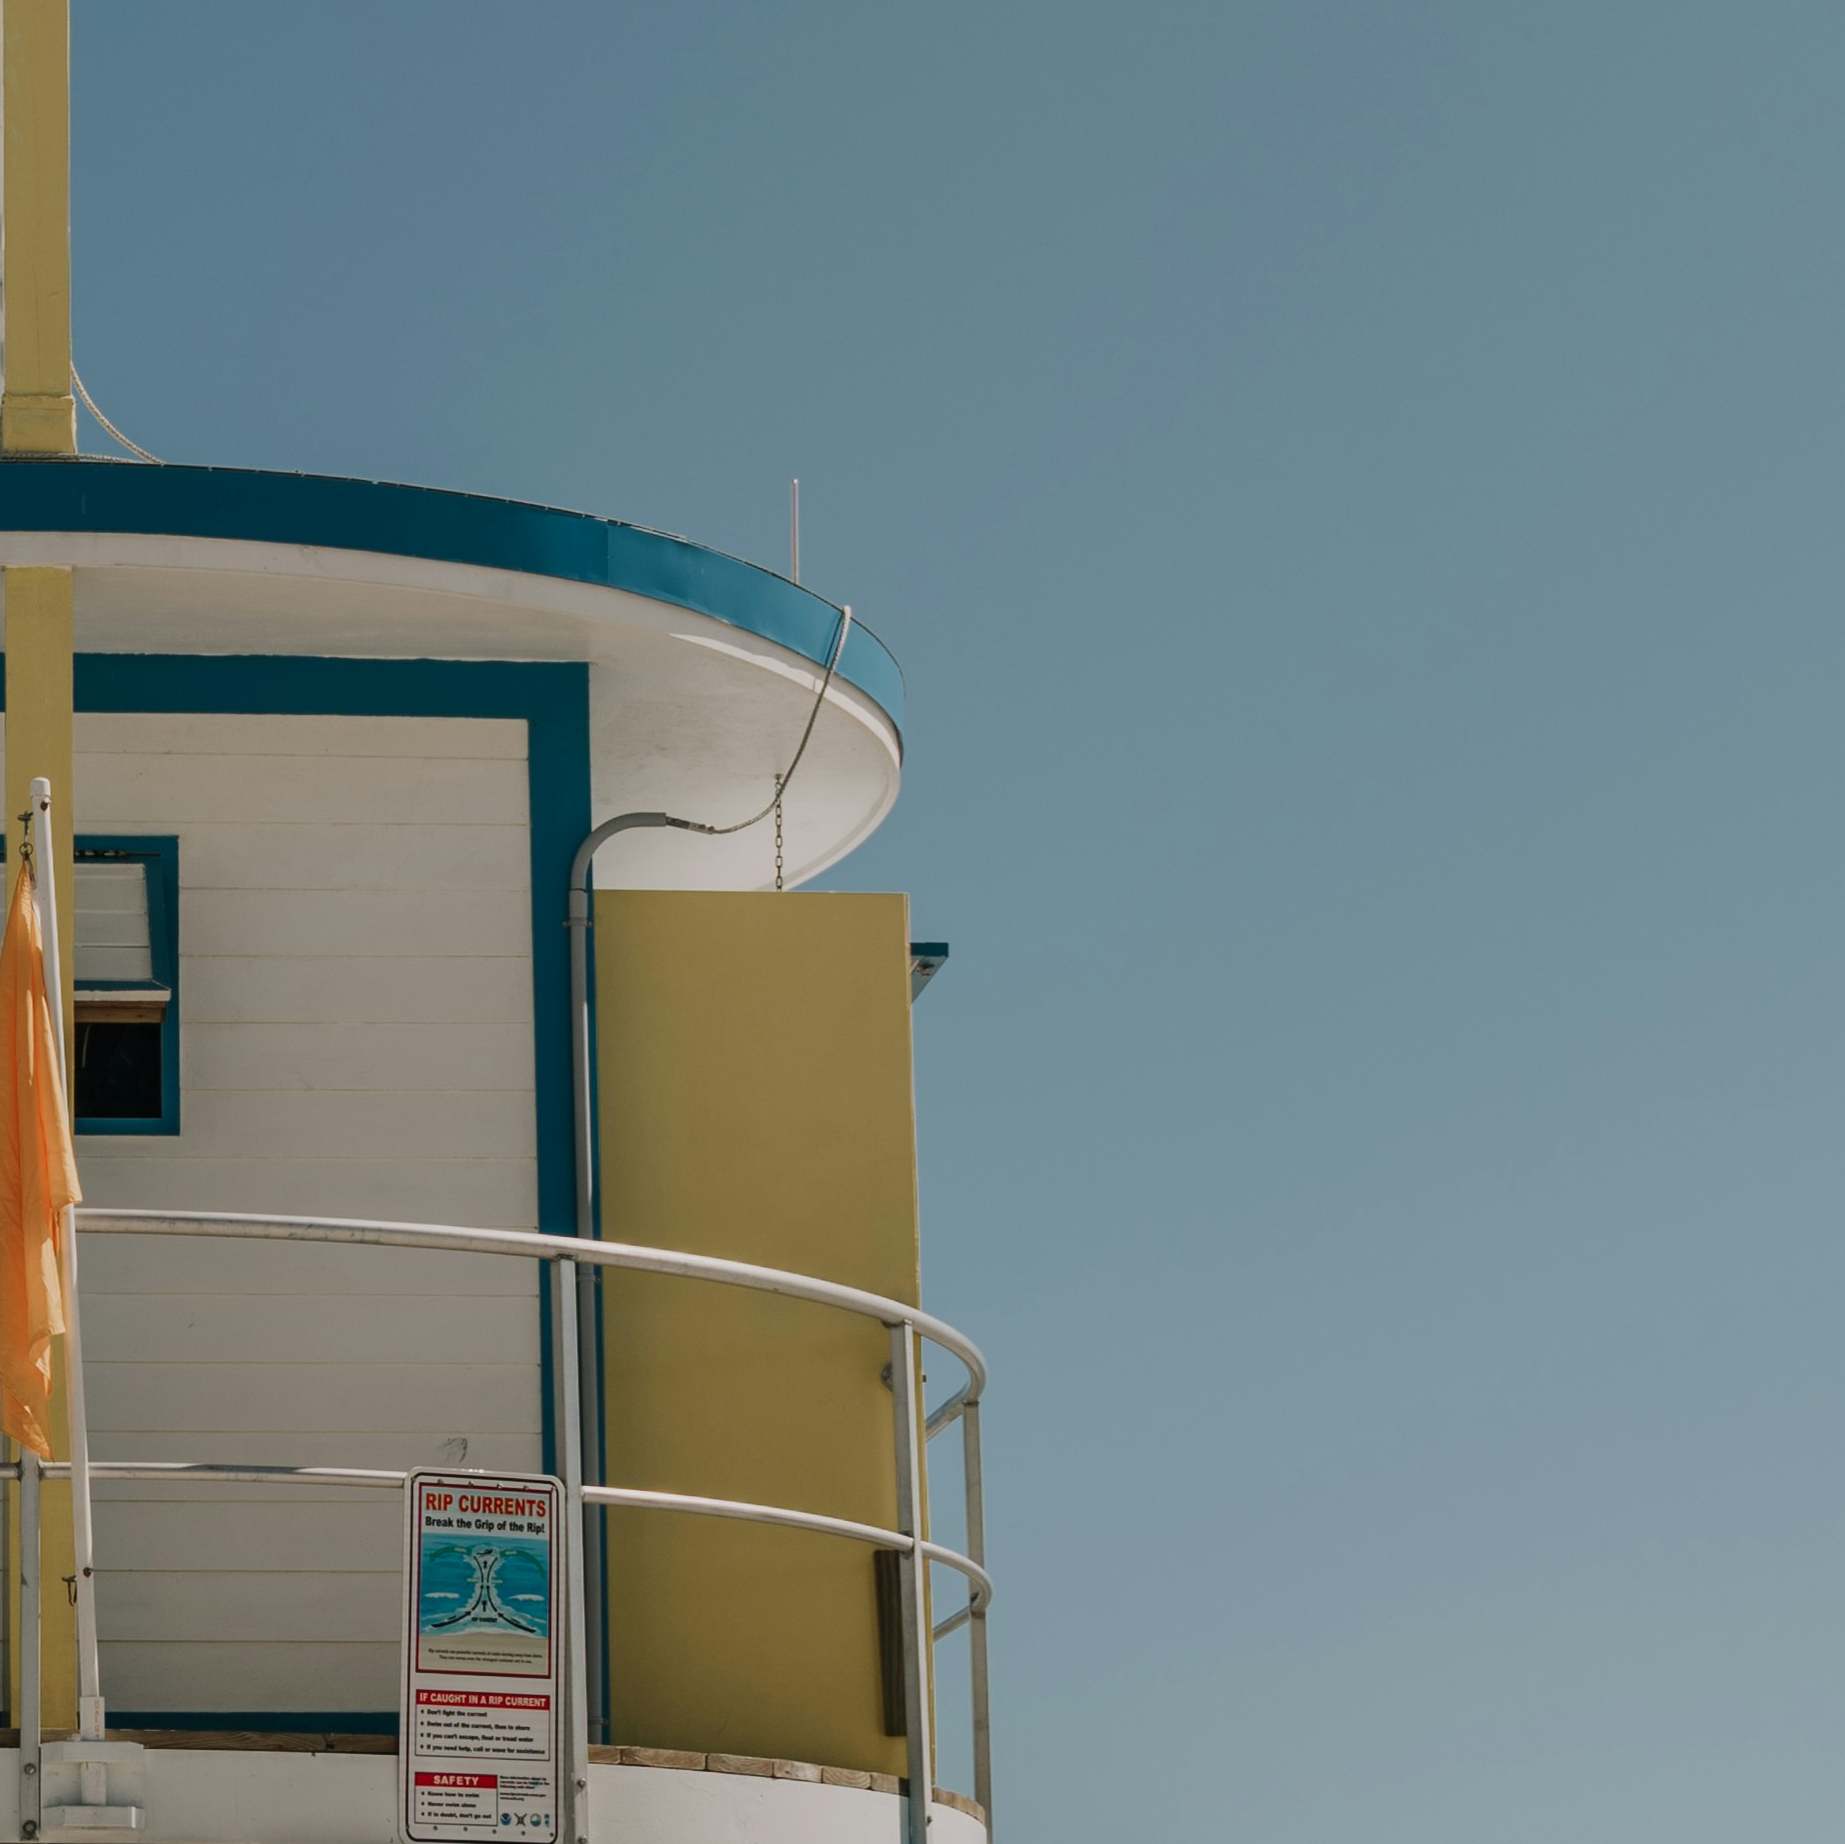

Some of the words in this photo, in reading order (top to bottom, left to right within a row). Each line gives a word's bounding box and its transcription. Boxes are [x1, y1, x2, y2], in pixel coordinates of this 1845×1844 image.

[426, 1492, 453, 1511] RIP
[459, 1494, 546, 1517] CURRENTS
[425, 1516, 454, 1528] Break
[456, 1518, 472, 1529] the
[475, 1519, 494, 1532] Grip
[497, 1520, 507, 1531] of
[509, 1521, 524, 1532] the
[527, 1522, 546, 1535] Rip!
[420, 1693, 428, 1702] IF
[430, 1693, 467, 1704] CAUGHT
[468, 1695, 478, 1704] IN
[480, 1696, 488, 1704] A
[488, 1696, 503, 1705] RIP
[505, 1696, 546, 1707] CURRENT
[433, 1775, 479, 1786] SAFETY
